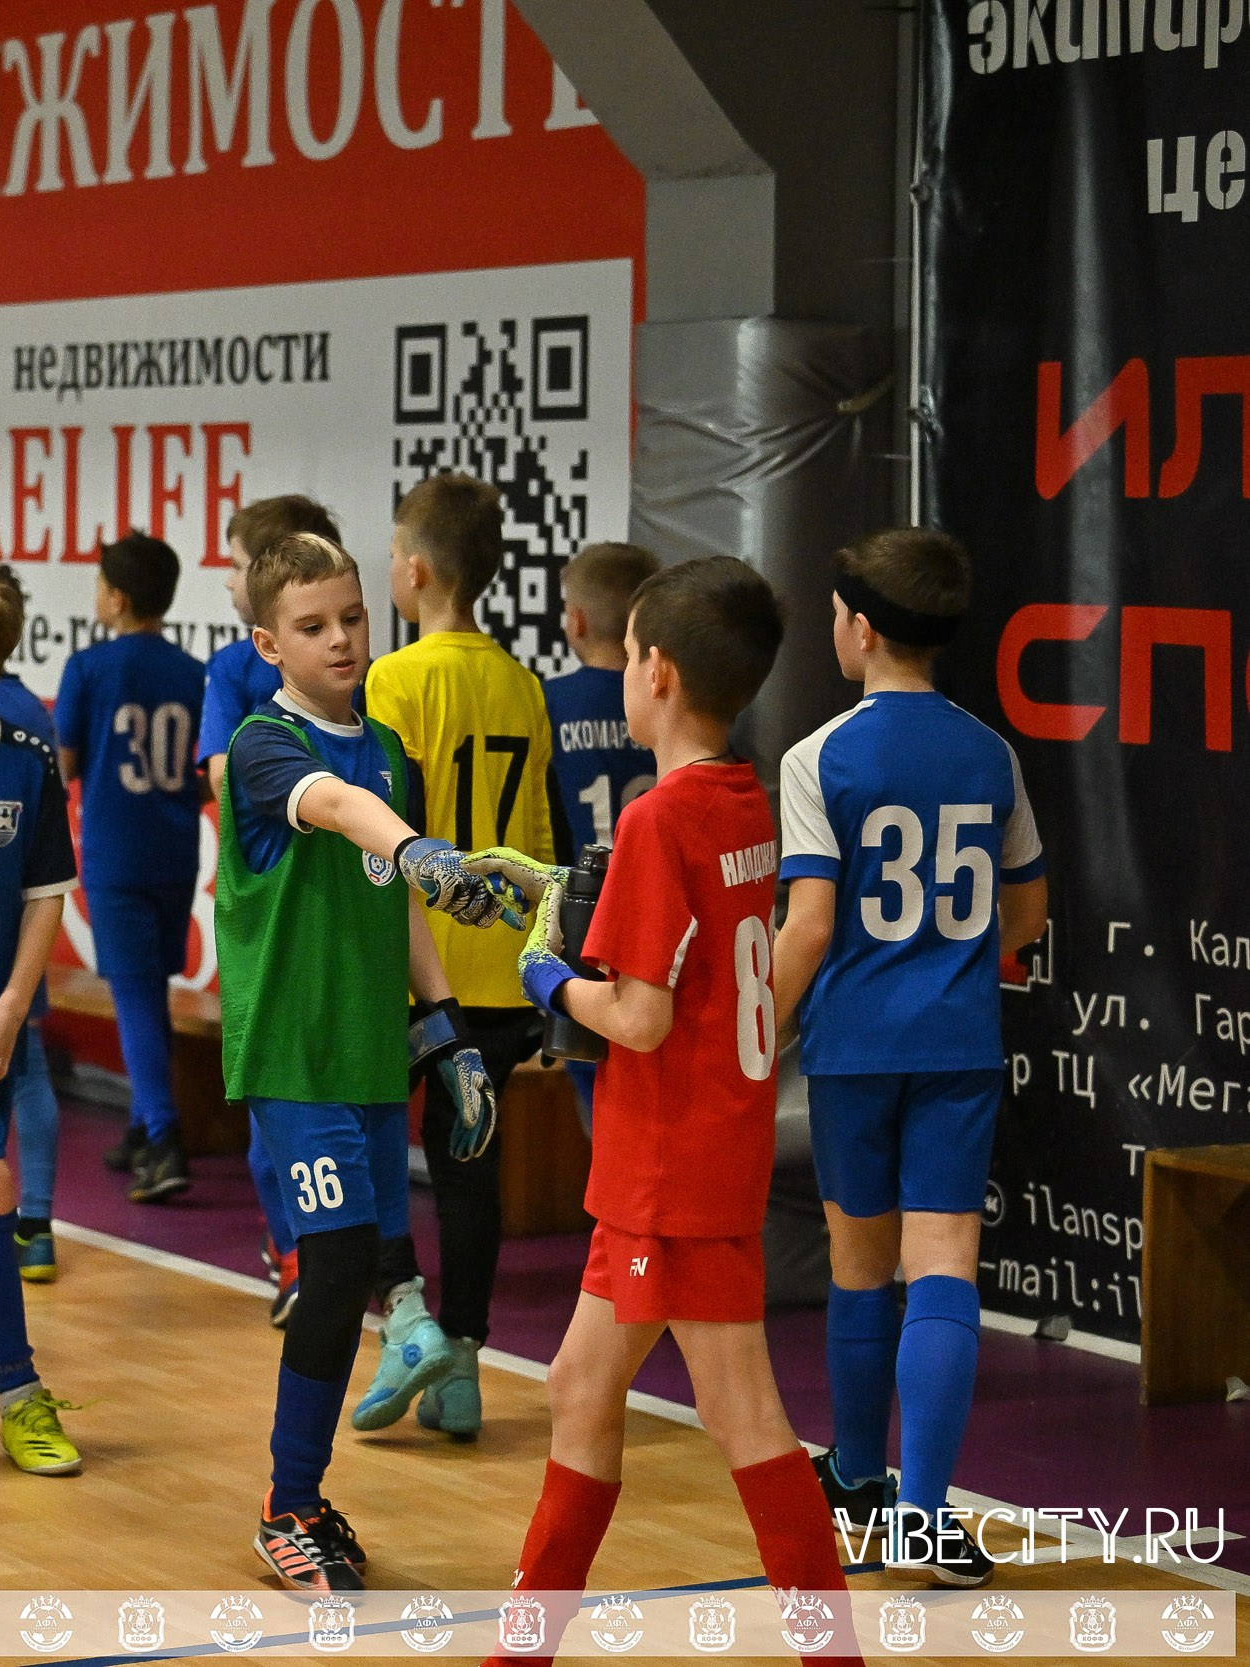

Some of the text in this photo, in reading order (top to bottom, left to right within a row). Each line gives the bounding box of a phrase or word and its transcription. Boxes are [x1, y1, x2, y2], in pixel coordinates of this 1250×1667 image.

[967, 0, 1250, 74] экипир
[1146, 130, 1246, 222] це
[13, 331, 332, 402] недвижимости
[1035, 355, 1250, 500] ИЛ
[996, 603, 1250, 752] СП
[113, 702, 191, 794] 30
[559, 719, 649, 752] СКОМАР
[452, 734, 530, 851] 17
[579, 774, 658, 850] 1
[860, 803, 994, 942] 35
[1107, 921, 1154, 957] г.
[734, 904, 776, 1081] 8
[1072, 991, 1150, 1036] ул.
[1052, 1050, 1096, 1109] ТЦ
[1128, 1063, 1250, 1114] «Мег
[290, 1156, 344, 1213] 36
